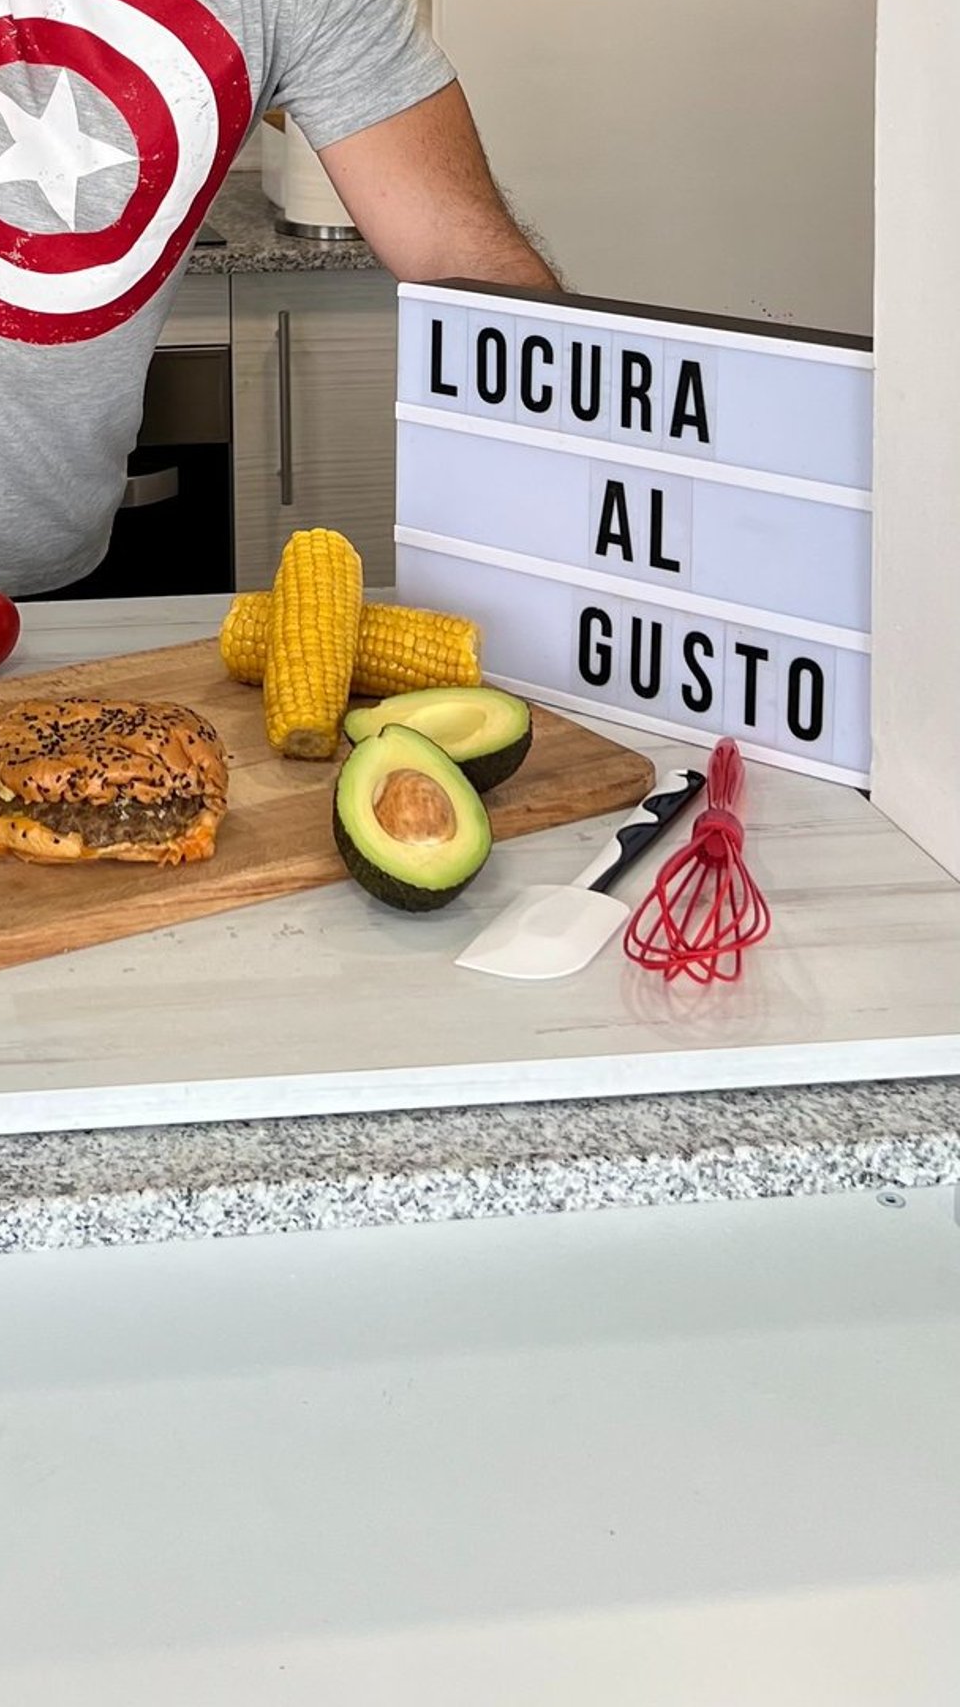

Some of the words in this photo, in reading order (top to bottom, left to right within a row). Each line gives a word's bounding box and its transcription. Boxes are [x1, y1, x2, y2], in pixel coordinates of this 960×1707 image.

[430, 319, 710, 444] LOCURA
[595, 479, 681, 573] AL
[578, 606, 824, 742] GUSTO
